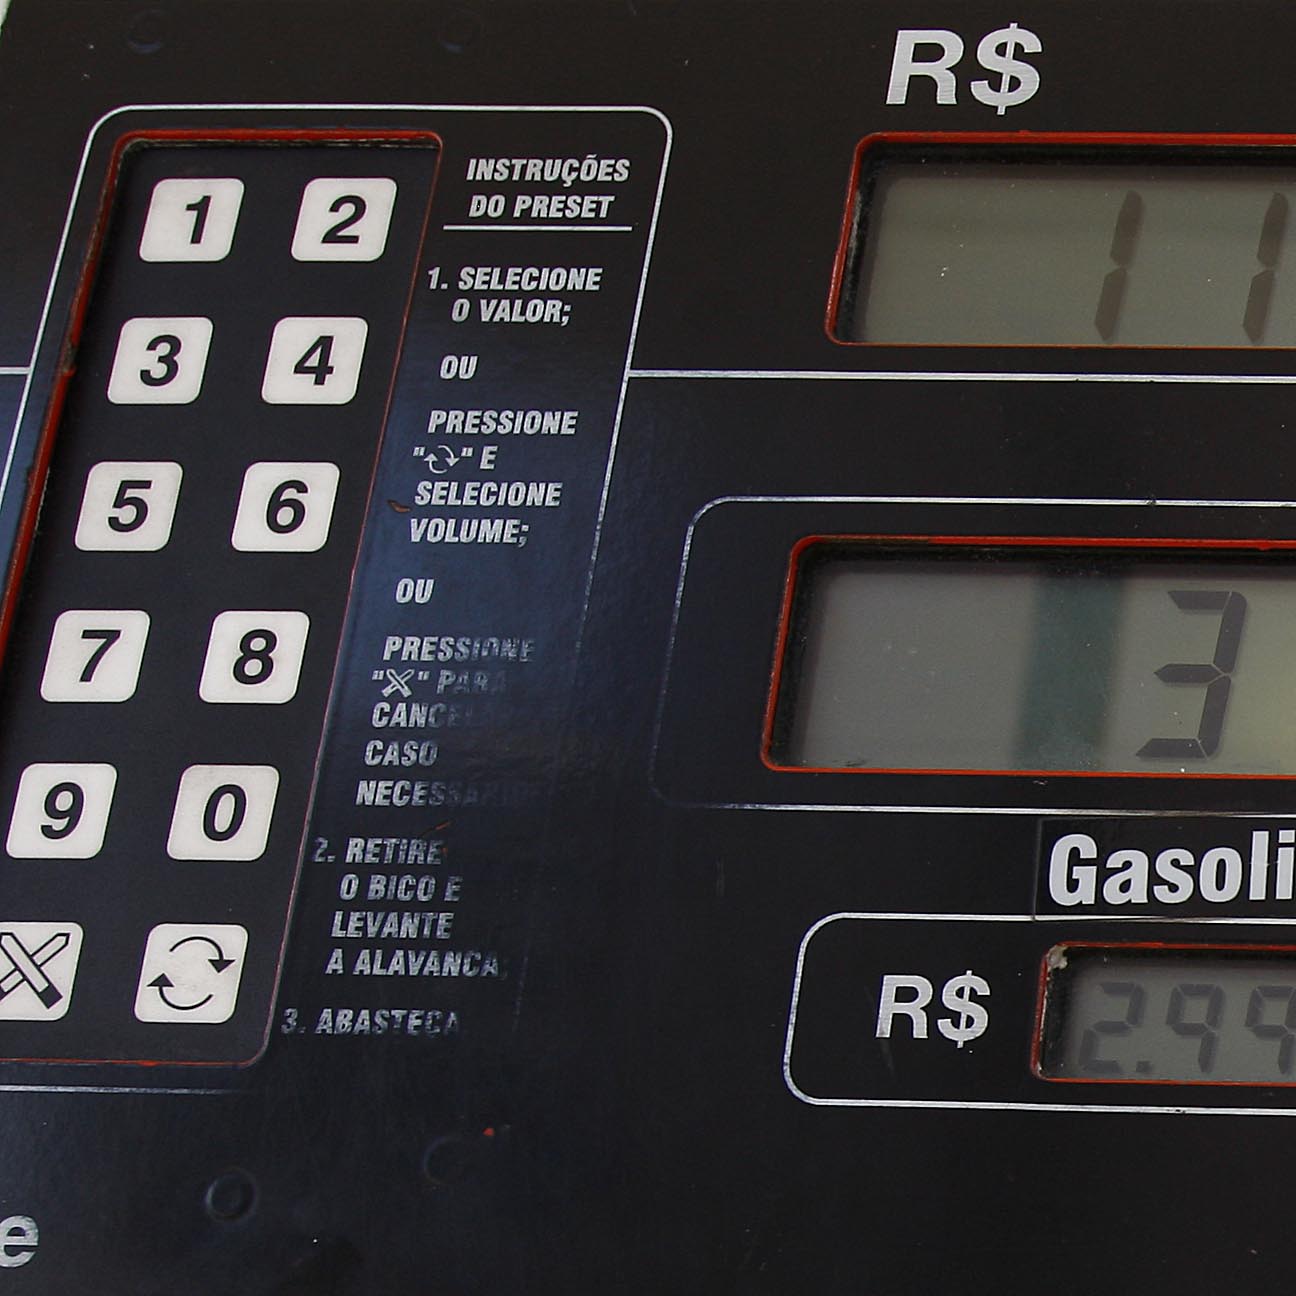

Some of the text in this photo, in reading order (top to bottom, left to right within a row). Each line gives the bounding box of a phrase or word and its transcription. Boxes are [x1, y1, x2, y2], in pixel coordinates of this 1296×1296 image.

[884, 23, 1044, 116] R$
[466, 154, 631, 187] INSTRUÇÕES
[185, 195, 213, 245] 1
[320, 195, 368, 245] 2
[468, 195, 616, 219] DO PRESET
[427, 266, 604, 291] 1. SELECIONE
[451, 299, 573, 327] O VALOR;
[139, 335, 183, 388] 3
[293, 335, 335, 387] 4
[440, 355, 479, 380] OU
[428, 410, 579, 435] PRESSIONE
[480, 445, 498, 470] E
[107, 479, 153, 533] 5
[265, 479, 309, 534] 6
[414, 481, 564, 507] SELECIONE
[410, 518, 531, 548] VOLUME;
[395, 577, 435, 604] OU
[79, 629, 121, 683] 7
[232, 629, 279, 685] 8
[364, 739, 439, 767] CASO
[40, 782, 86, 840] 9
[202, 784, 247, 842] 0
[345, 837, 446, 865] RETIRE
[339, 873, 360, 901] O
[367, 874, 437, 902] BICO
[331, 910, 456, 940] LEVANTE
[325, 948, 344, 975] A
[875, 968, 992, 1049] R$
